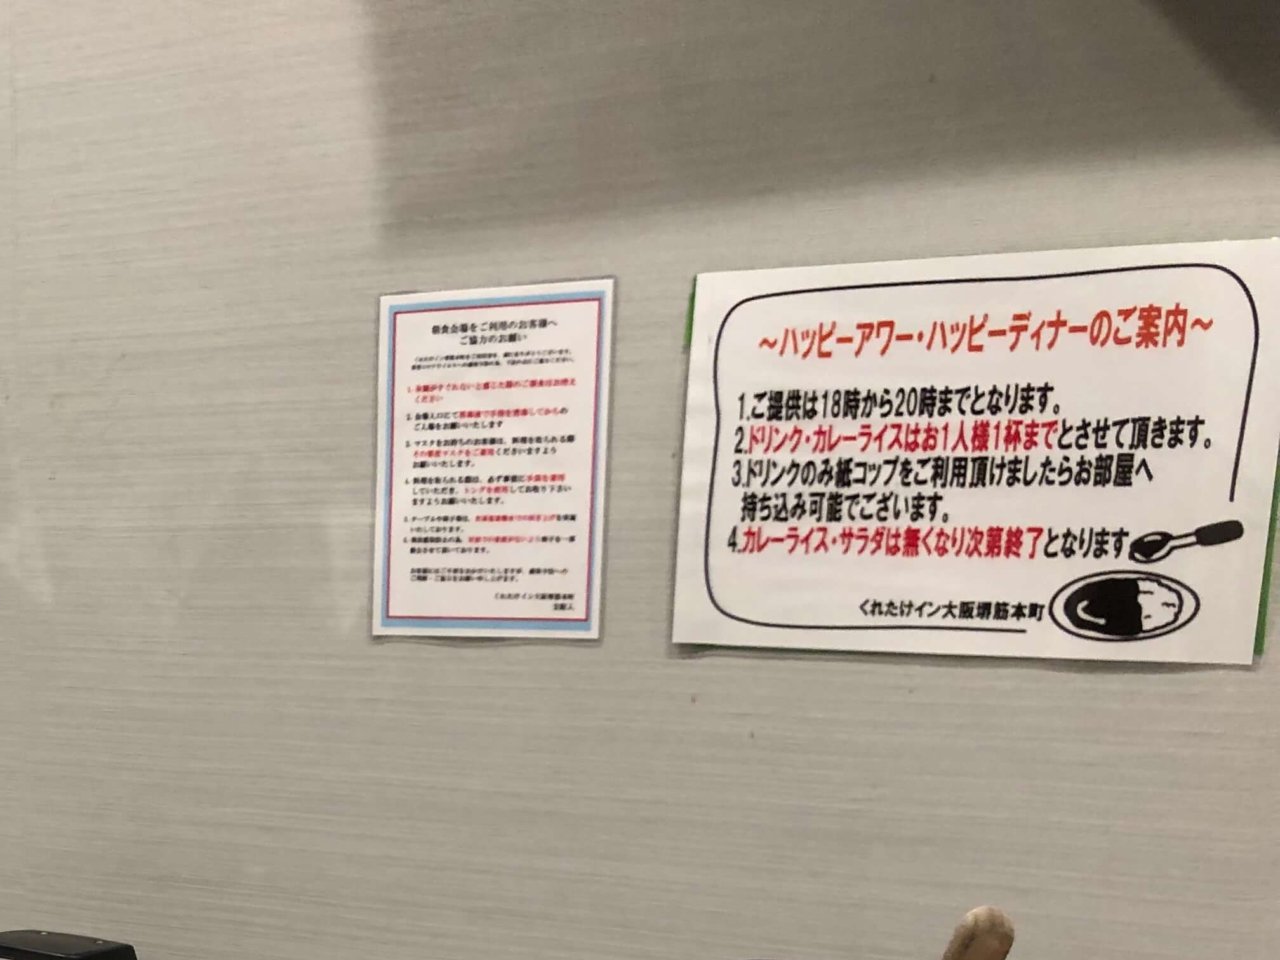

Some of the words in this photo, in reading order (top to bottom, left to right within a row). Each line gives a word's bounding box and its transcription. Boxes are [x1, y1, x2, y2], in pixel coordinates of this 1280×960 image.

[738, 383, 1060, 421] 1.ご提供は18時から20時までとなります。
[732, 453, 1153, 488] 3.ドリンクのみ紙コップをご利用頂けましたらお部屋へ
[741, 491, 950, 523] 持ち込み可能でございます。
[859, 598, 1045, 622] くれたけイン大阪堺筋本町
